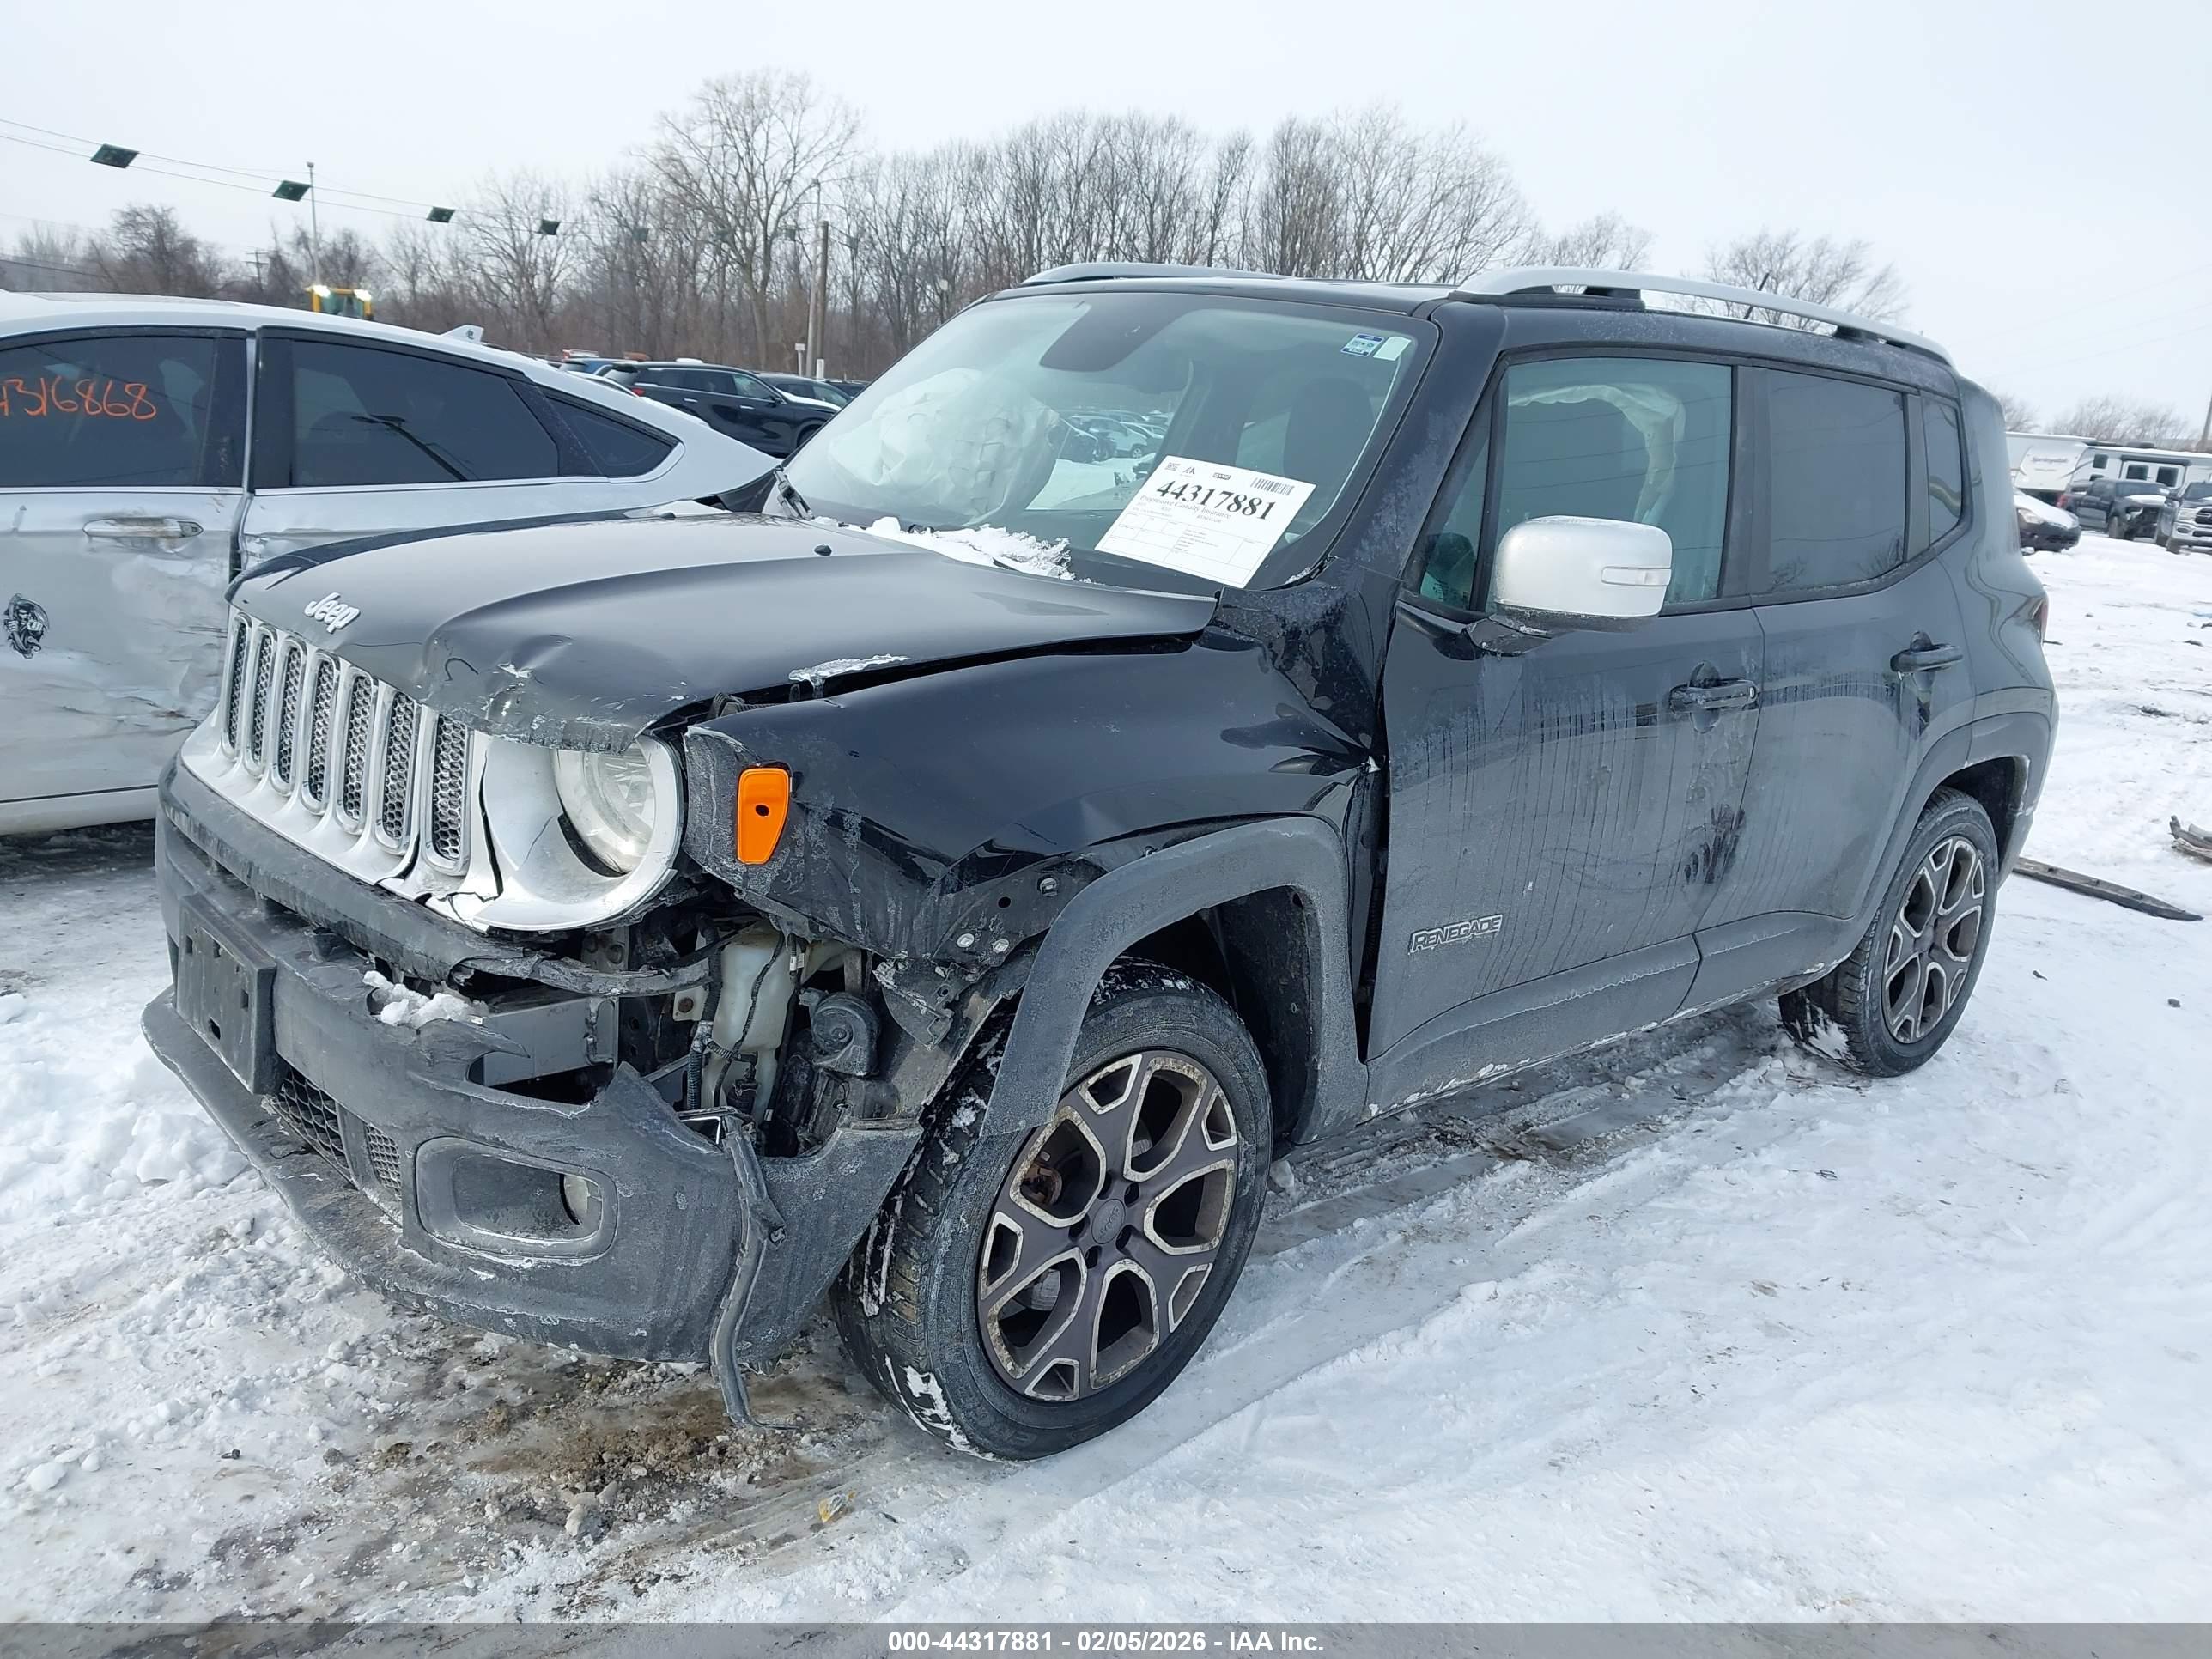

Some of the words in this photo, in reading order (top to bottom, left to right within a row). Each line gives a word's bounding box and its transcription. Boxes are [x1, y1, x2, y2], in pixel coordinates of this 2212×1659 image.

[1157, 480, 1277, 520] 44317881
[304, 592, 361, 634] Jeep
[1409, 914, 1503, 953] RENEGADE
